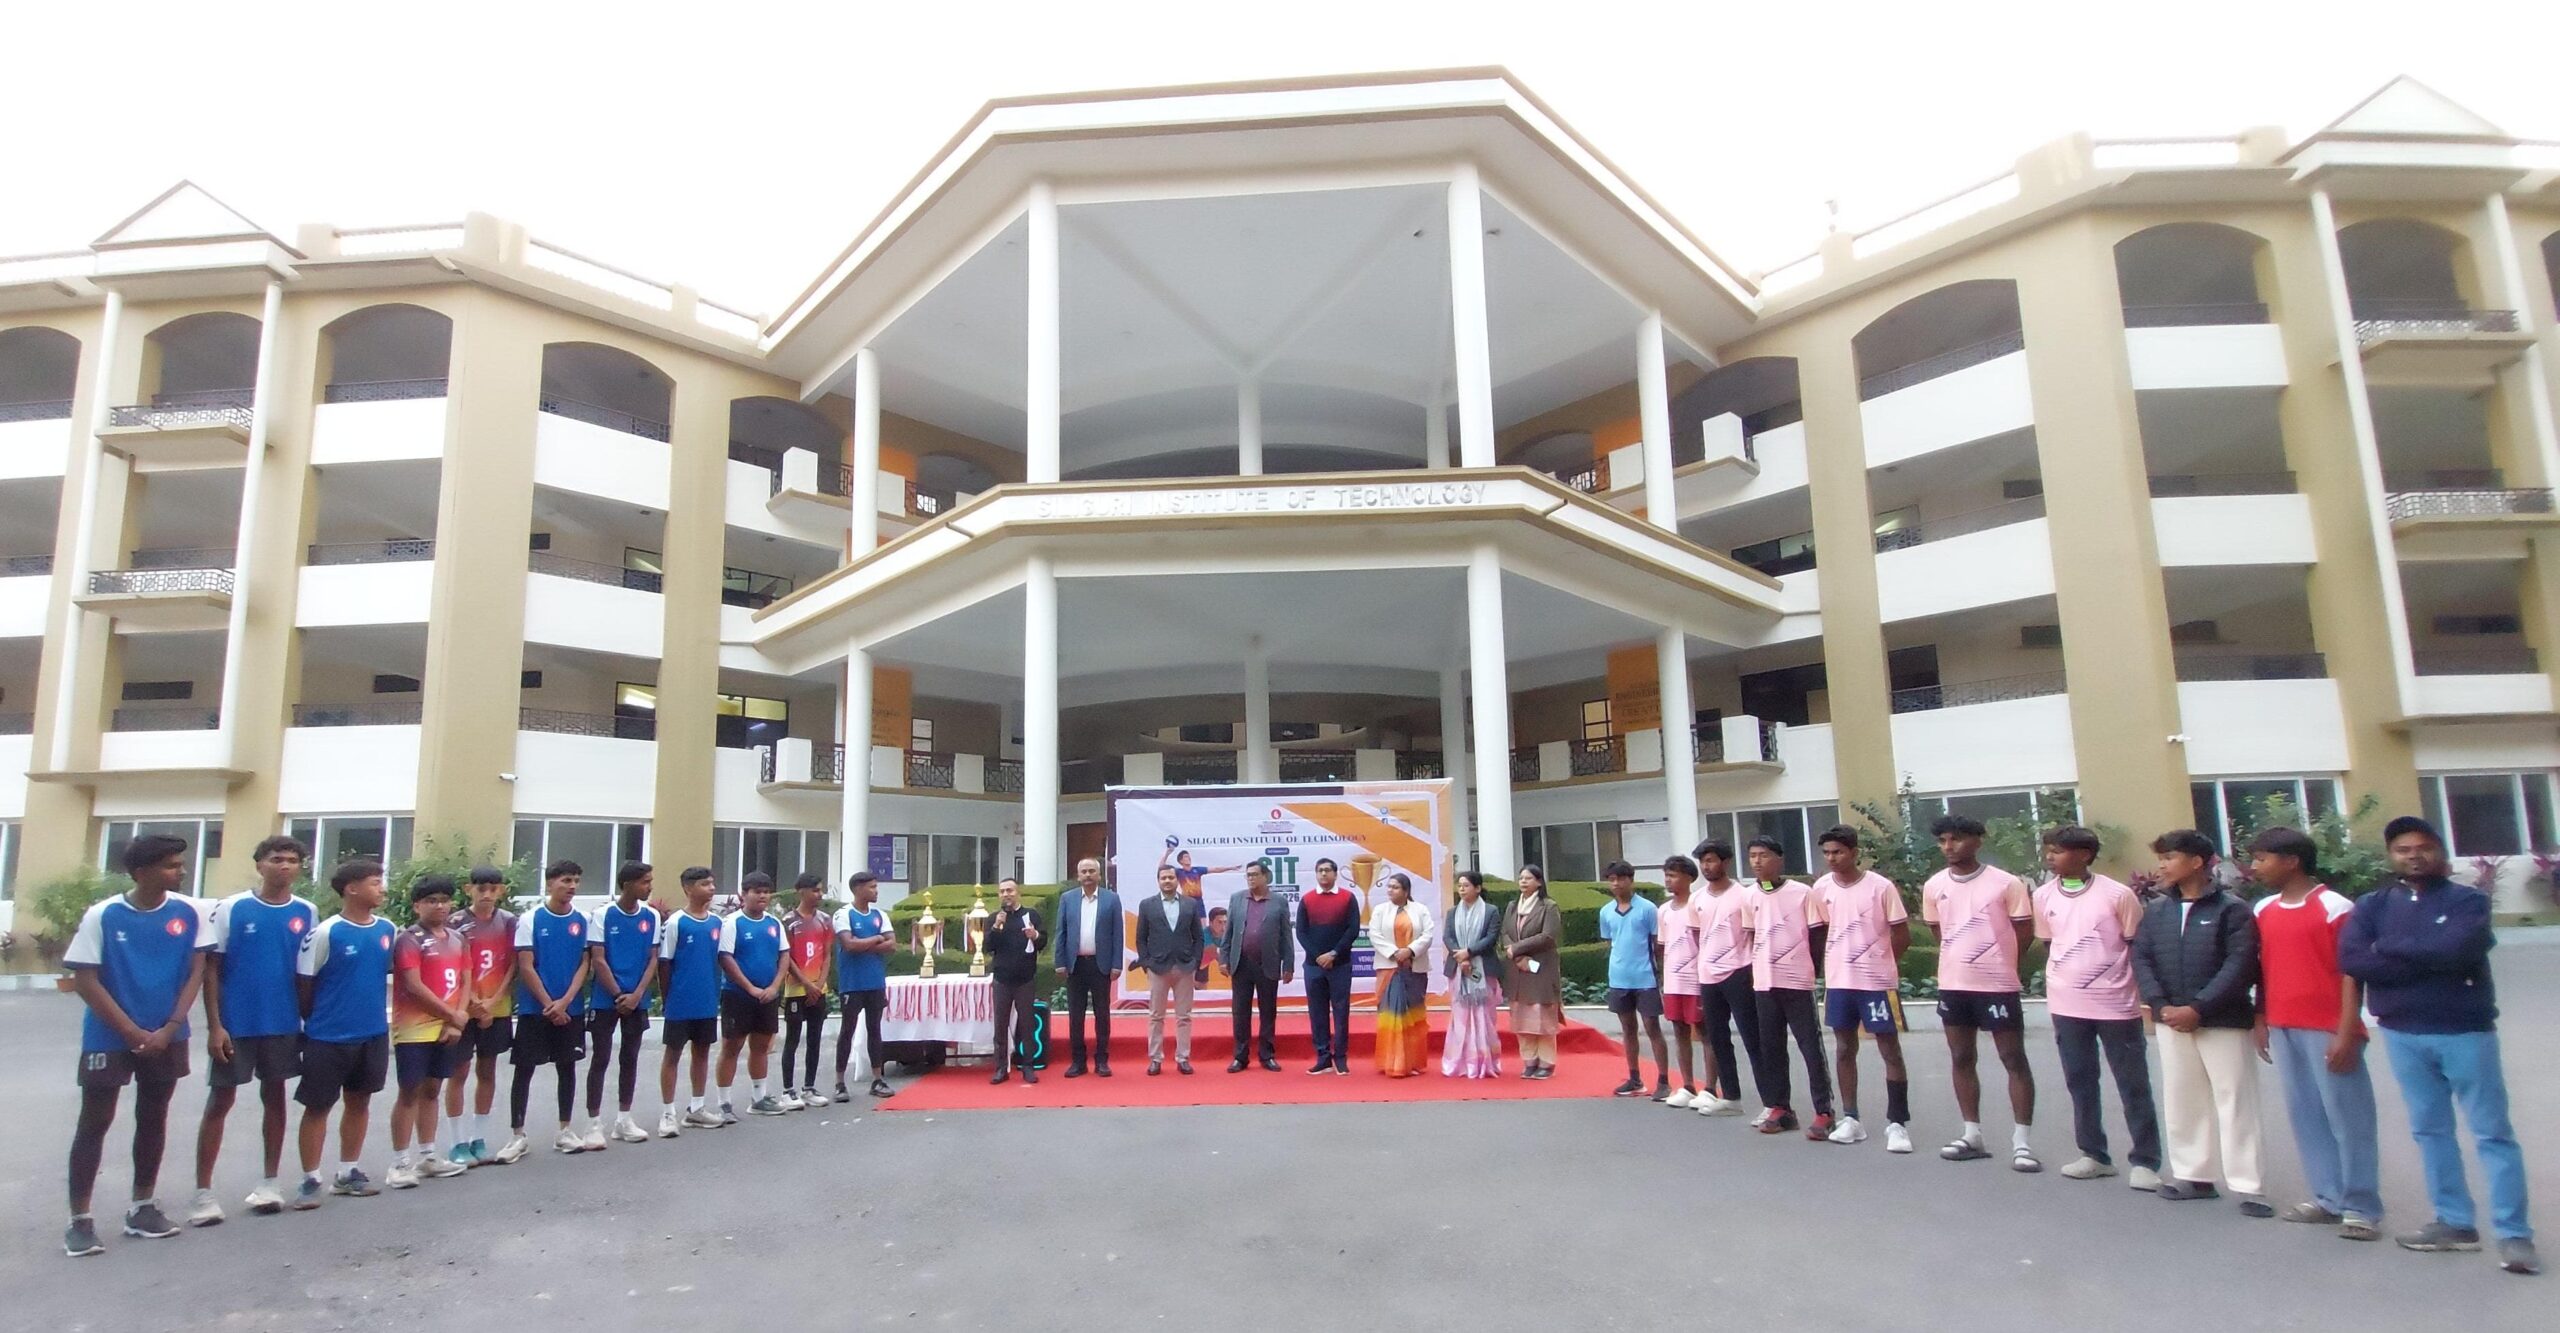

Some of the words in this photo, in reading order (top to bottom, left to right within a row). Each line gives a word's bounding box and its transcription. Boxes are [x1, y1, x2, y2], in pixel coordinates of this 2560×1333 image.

[1038, 494, 1132, 518] SILIGURI
[1148, 490, 1269, 515] INSTITUTE
[1287, 489, 1316, 509] OF
[1333, 483, 1487, 508] TECHNOLOGY
[1187, 837, 1230, 845] SILIGURI
[1232, 836, 1283, 845] INSTITUTE
[1286, 835, 1298, 843] OF
[1302, 834, 1367, 843] TECHNOLOGY
[806, 942, 814, 957] 8
[480, 949, 493, 969] 3
[445, 968, 457, 989] 9
[844, 994, 850, 1005] 7
[1867, 1000, 1889, 1022] 14
[1988, 1004, 2009, 1019] 14
[87, 1052, 107, 1070] 10
